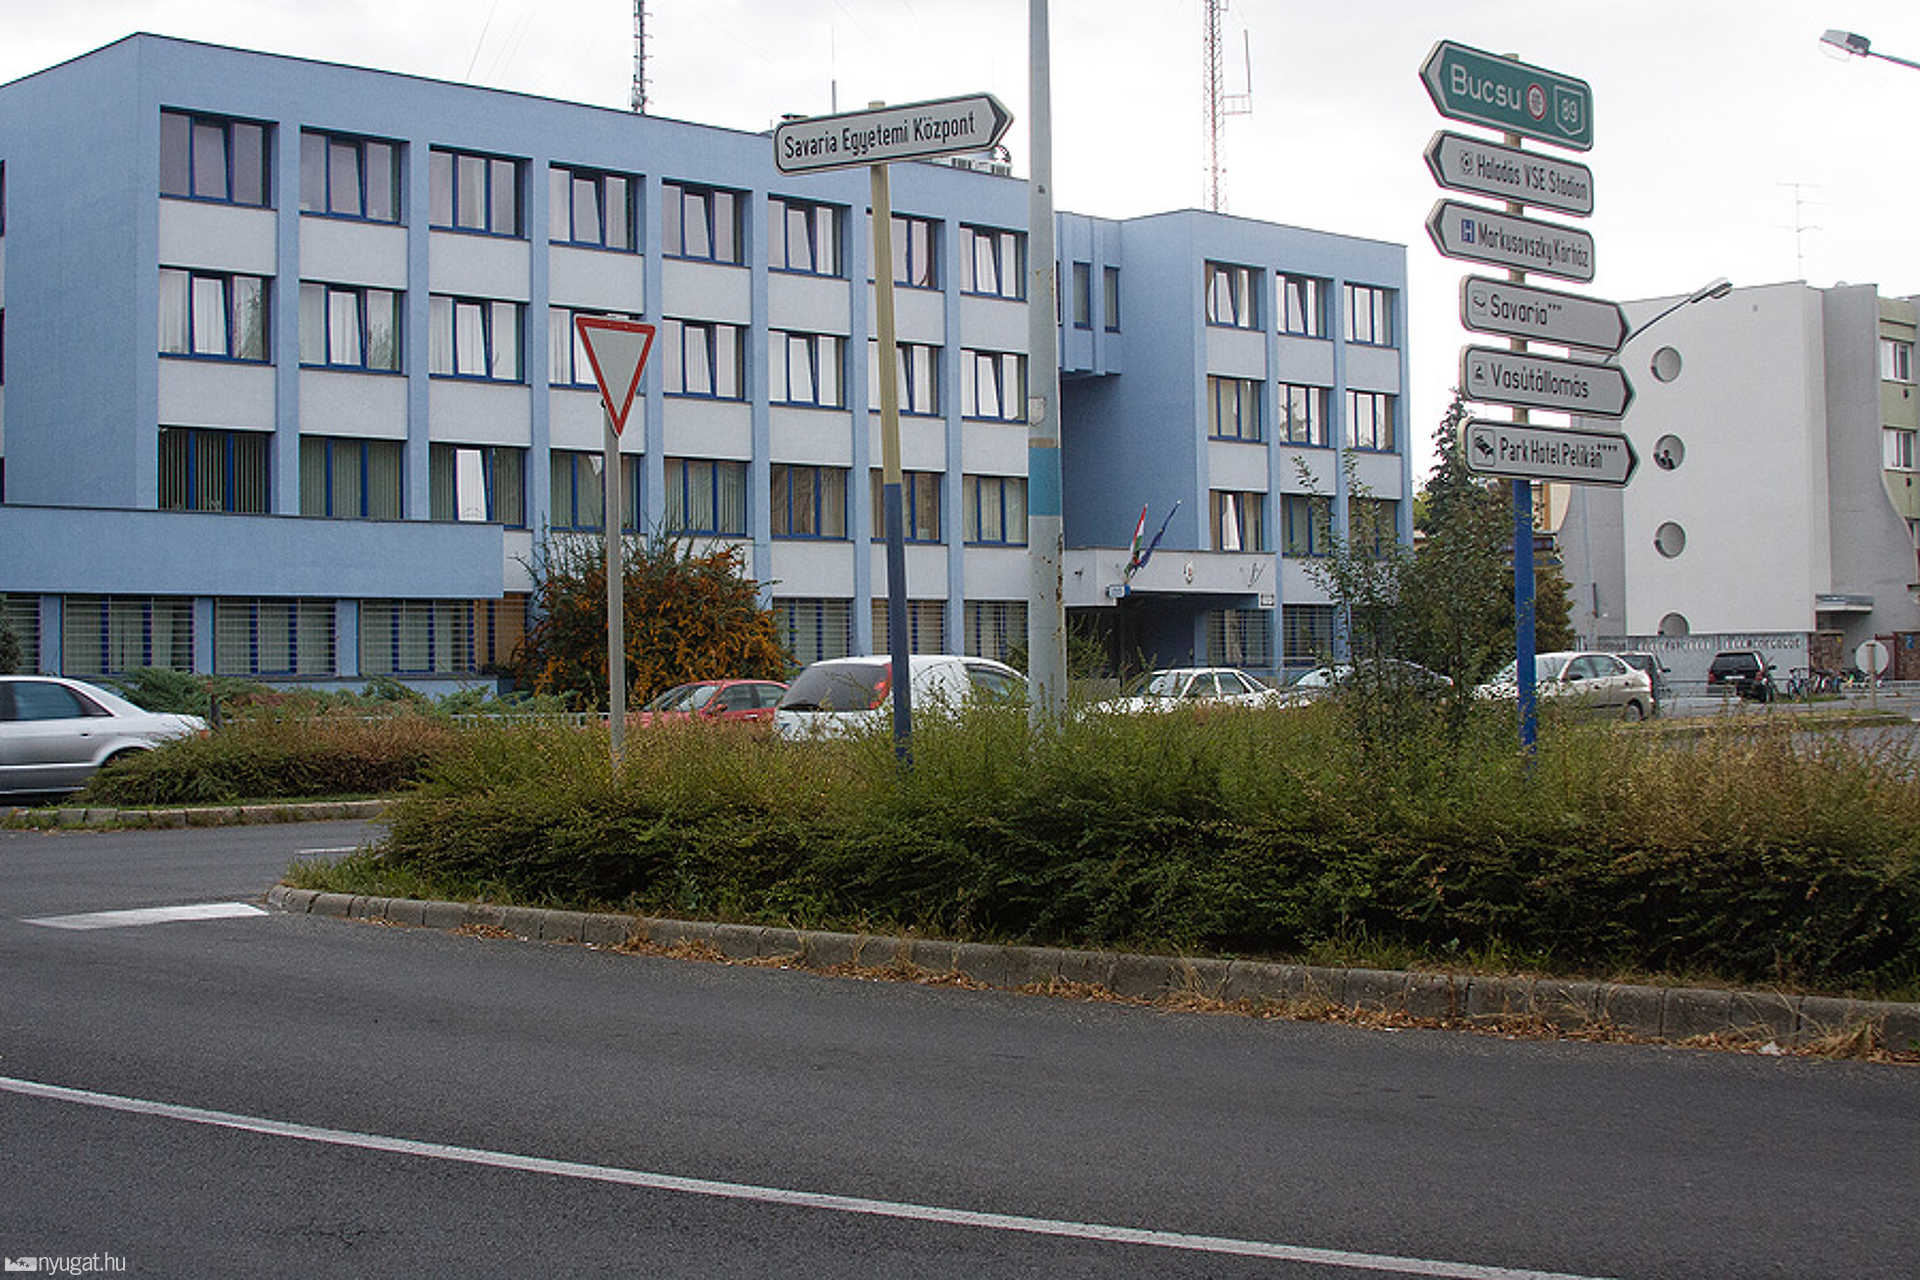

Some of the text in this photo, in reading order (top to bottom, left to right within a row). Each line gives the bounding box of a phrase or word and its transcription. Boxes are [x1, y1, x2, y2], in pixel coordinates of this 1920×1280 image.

[1450, 63, 1523, 111] Bucsu
[1561, 98, 1578, 122] 89
[784, 110, 975, 159] Savaria Egyetemi Központ
[1477, 153, 1520, 185] Haladás
[1523, 163, 1545, 191] VSE
[1490, 293, 1548, 325] Savaria
[1490, 361, 1590, 398] Vasútállomás
[1500, 437, 1528, 462] Park
[1530, 439, 1560, 464] Hotel
